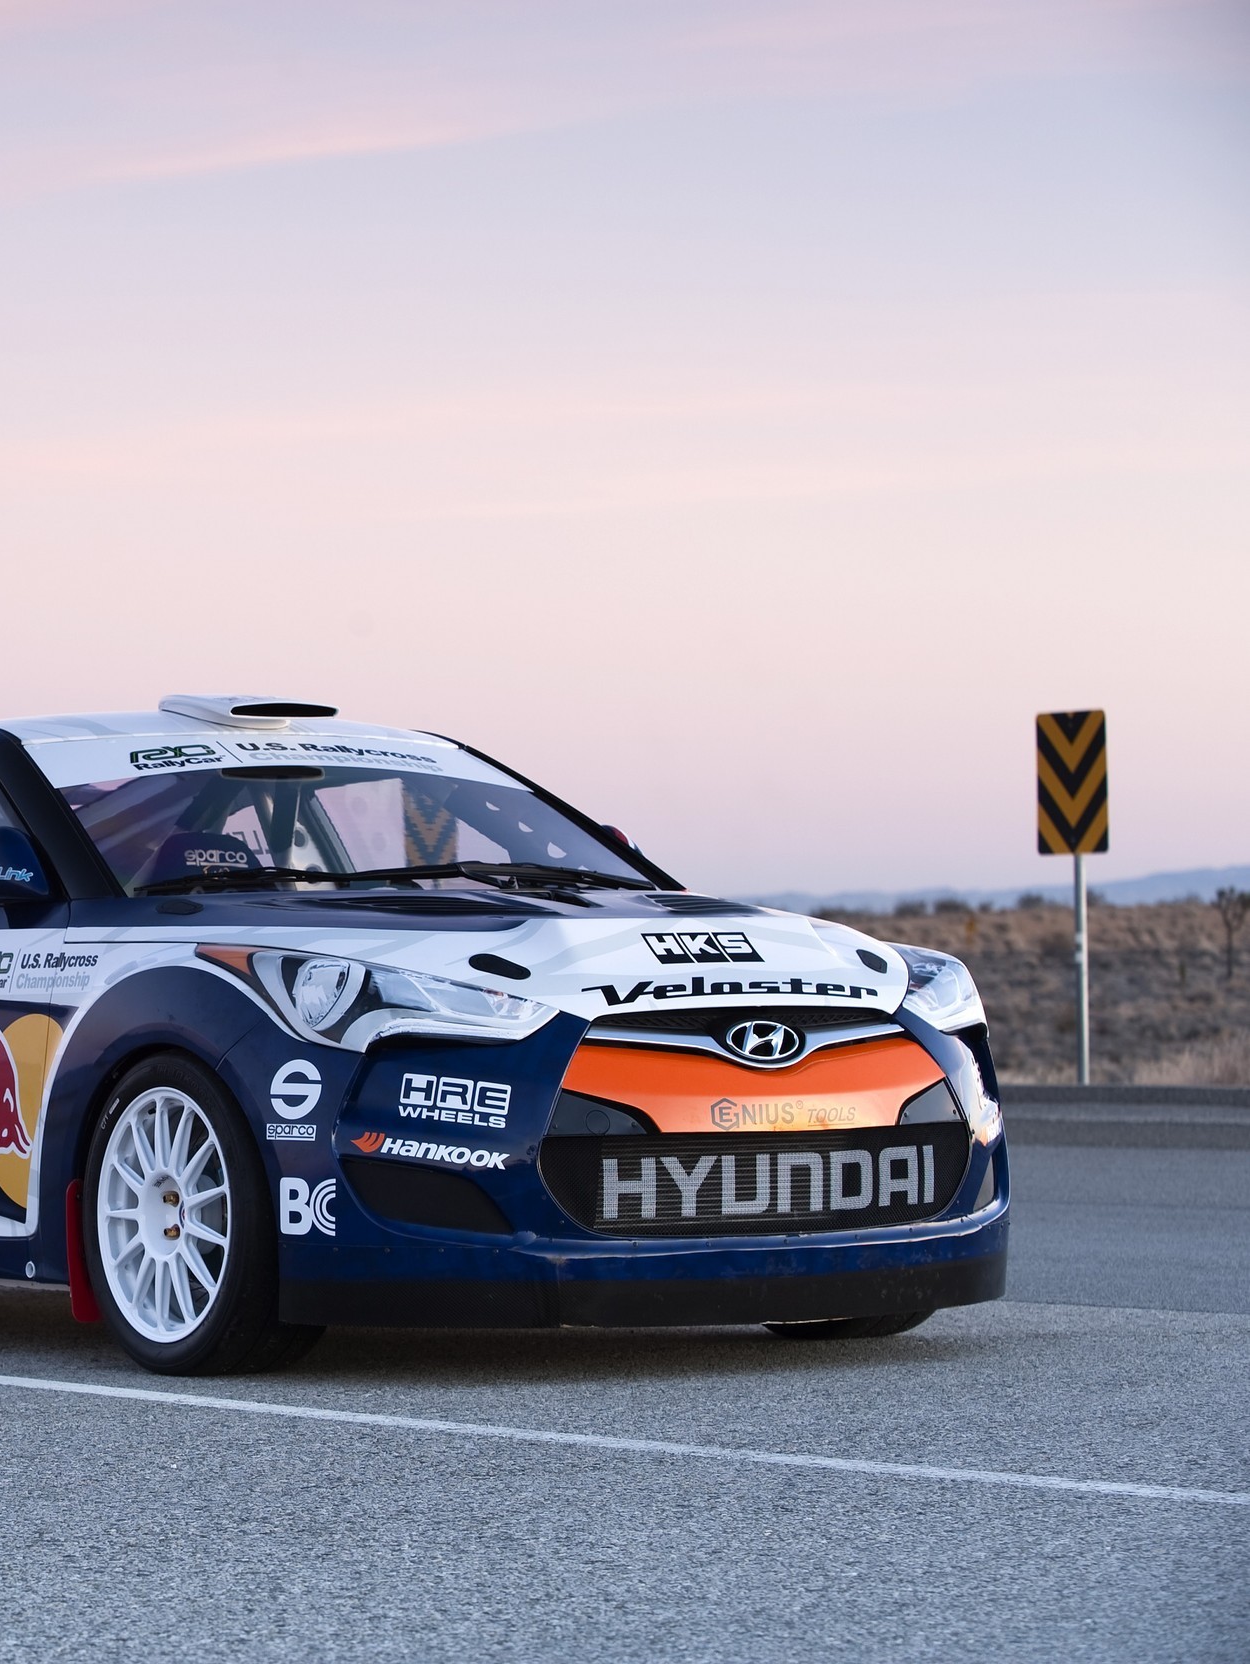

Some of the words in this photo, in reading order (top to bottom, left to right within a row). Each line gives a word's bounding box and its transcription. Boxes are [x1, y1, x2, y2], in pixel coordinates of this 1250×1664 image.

[133, 757, 222, 771] RallyCar
[236, 742, 297, 751] U.S.
[299, 743, 437, 764] Rallycross
[249, 751, 443, 773] Championship
[184, 849, 248, 867] sparco
[642, 933, 760, 960] HKS
[20, 953, 41, 970] U.S.
[43, 952, 99, 972] Rallycross
[16, 971, 90, 993] Championship
[581, 976, 878, 1006] Veloster
[400, 1073, 512, 1115] HRE
[398, 1106, 506, 1129] WHEELS
[807, 1106, 856, 1125] TOOLS
[266, 1124, 317, 1142] sparco
[602, 1144, 935, 1220] HYUNDAI
